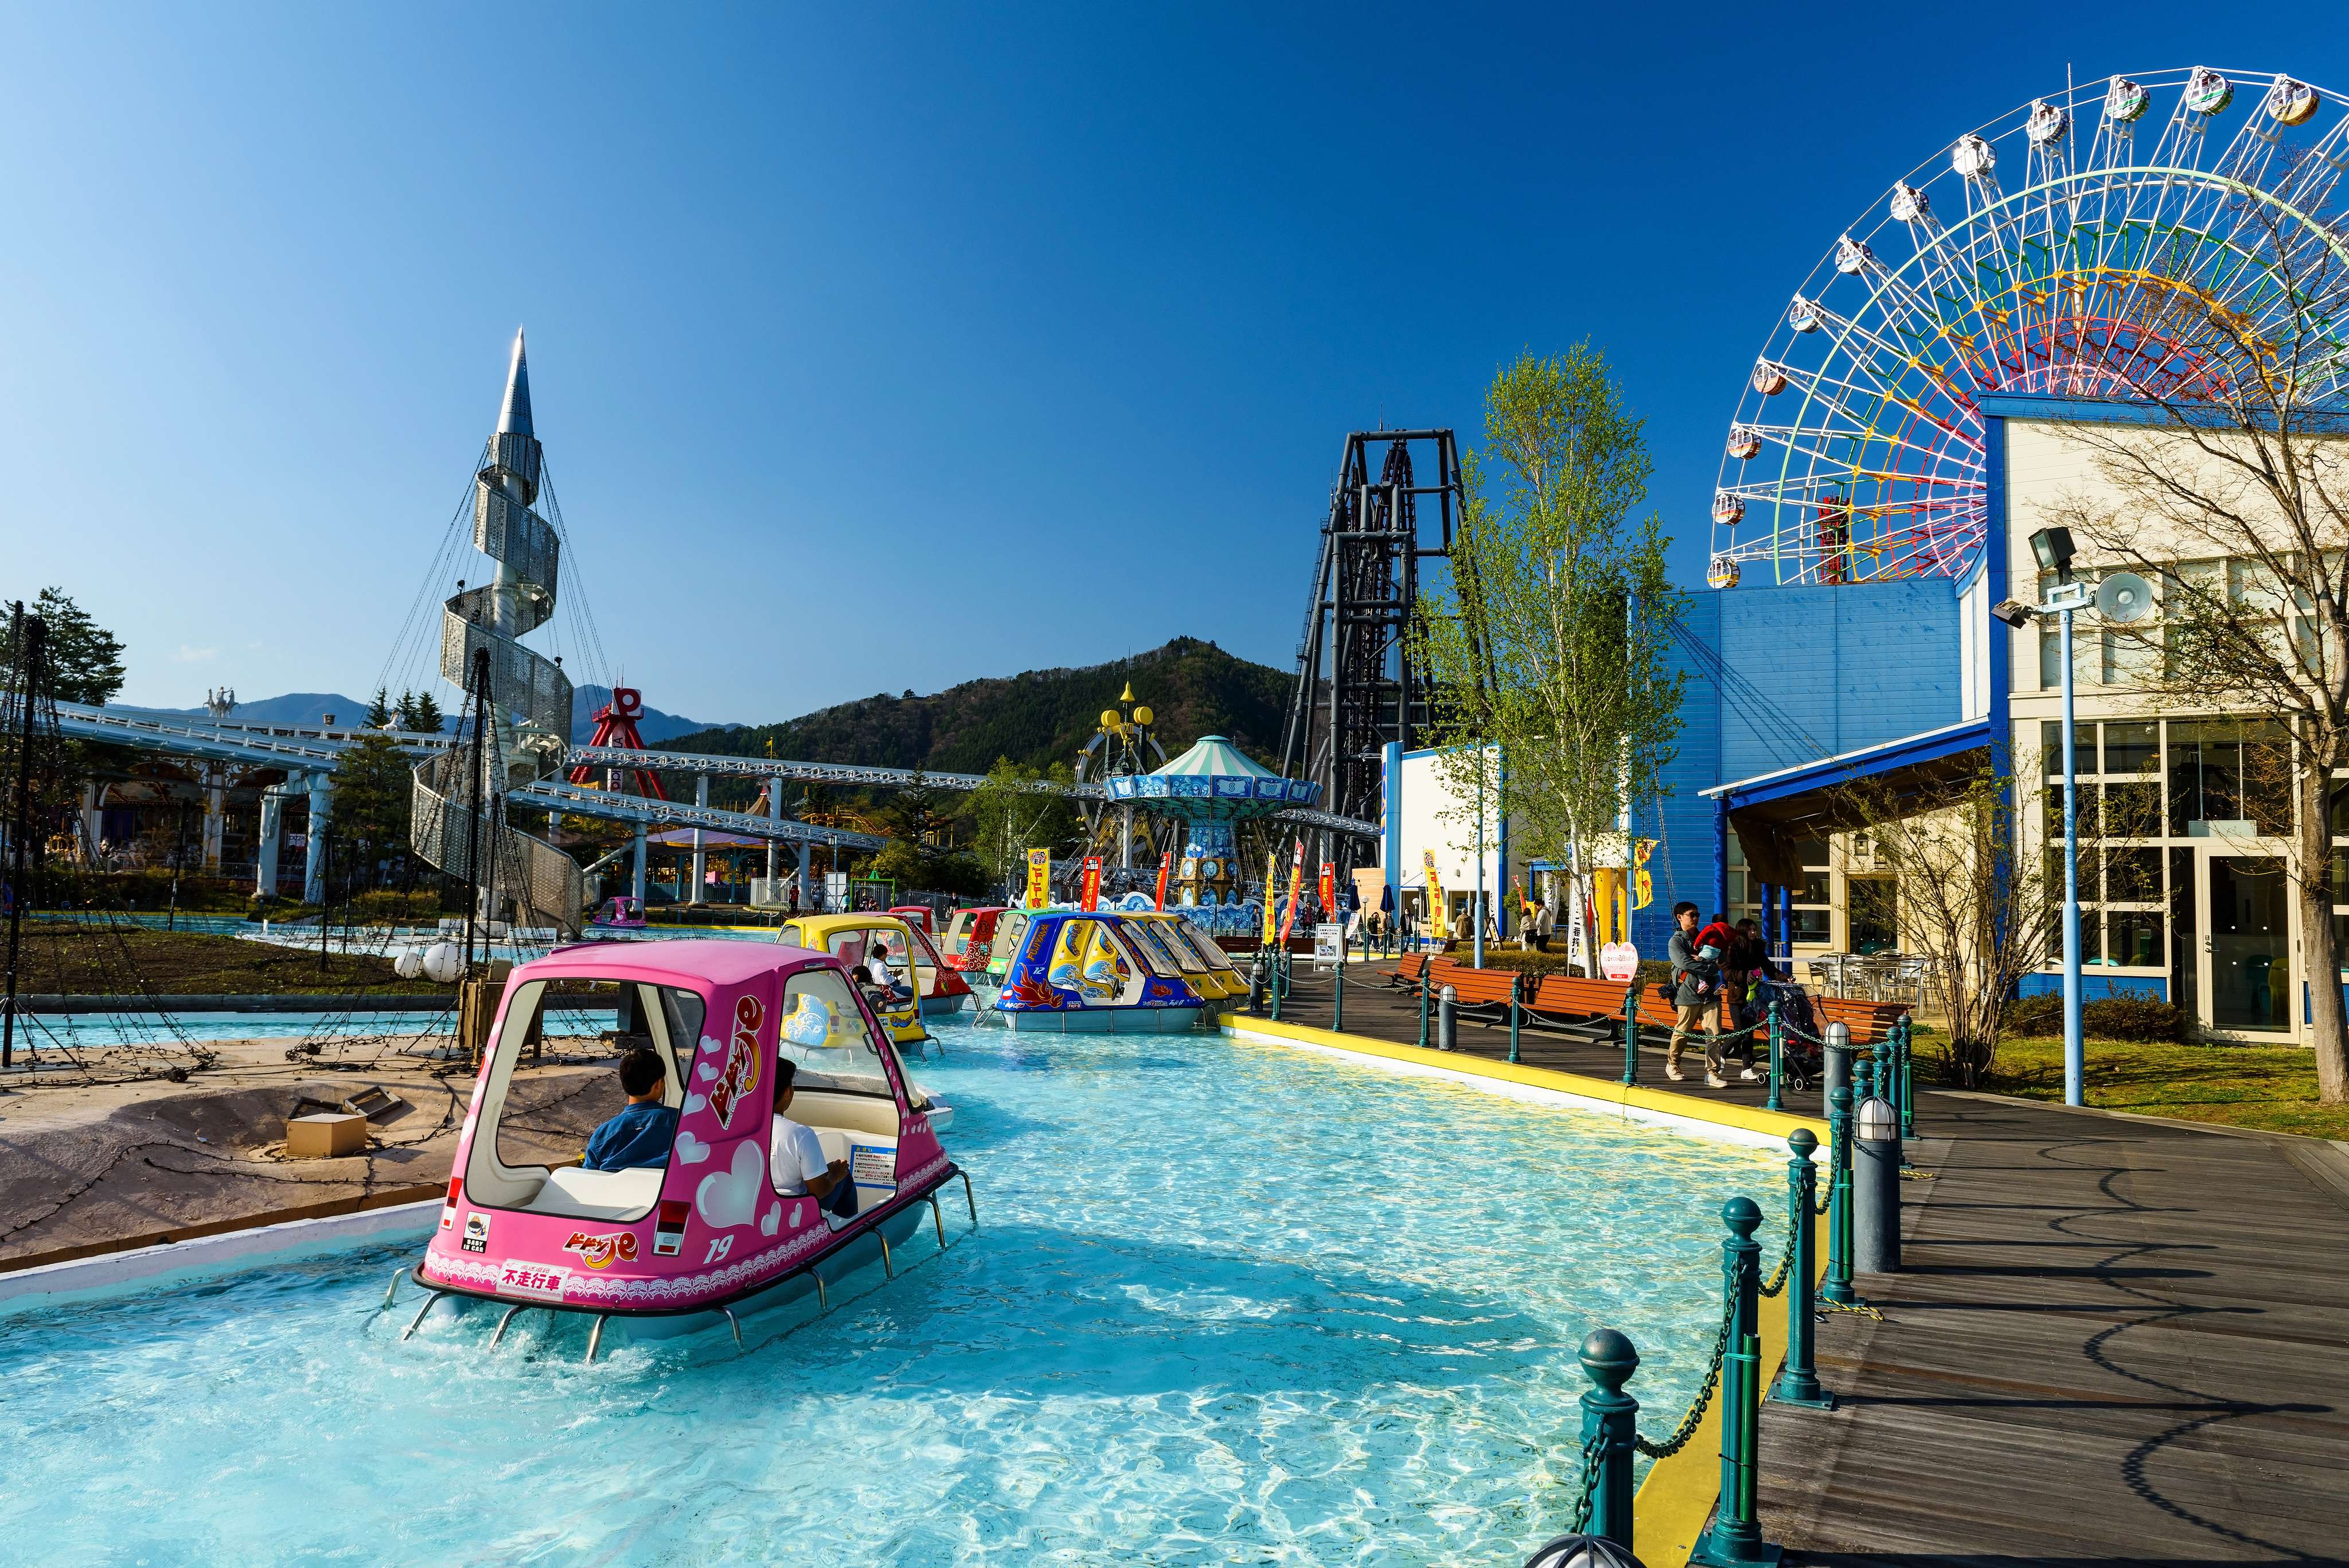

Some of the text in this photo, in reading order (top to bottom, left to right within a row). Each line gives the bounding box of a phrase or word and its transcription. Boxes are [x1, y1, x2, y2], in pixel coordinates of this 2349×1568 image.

[1027, 924, 1051, 962] FUJIYAMA
[467, 1239, 483, 1247] BABY
[703, 1234, 734, 1265] 19
[502, 1269, 561, 1291] 不走行車
